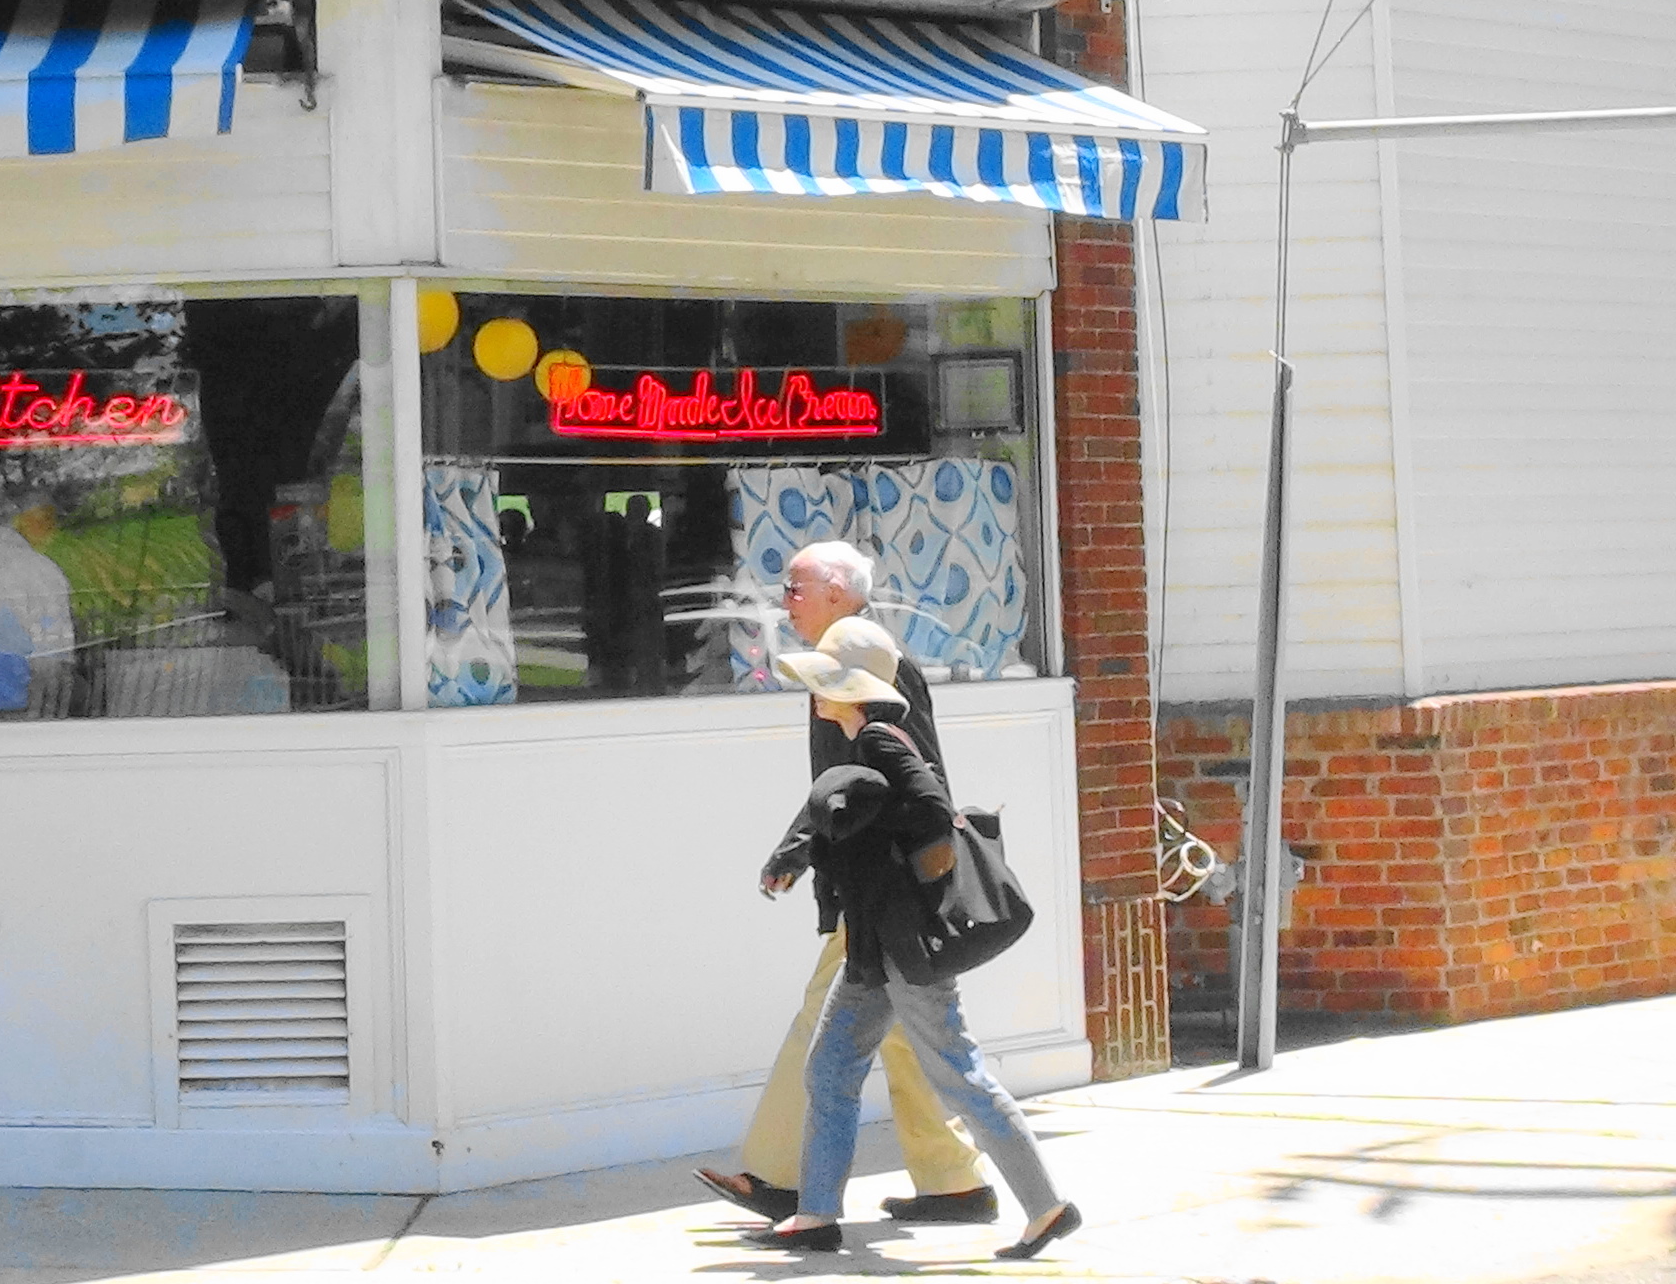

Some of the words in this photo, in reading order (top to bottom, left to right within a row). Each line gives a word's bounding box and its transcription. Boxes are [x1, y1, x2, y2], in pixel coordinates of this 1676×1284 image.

[636, 371, 720, 429] Made
[721, 368, 781, 429] Ice
[782, 373, 878, 429] Cream
